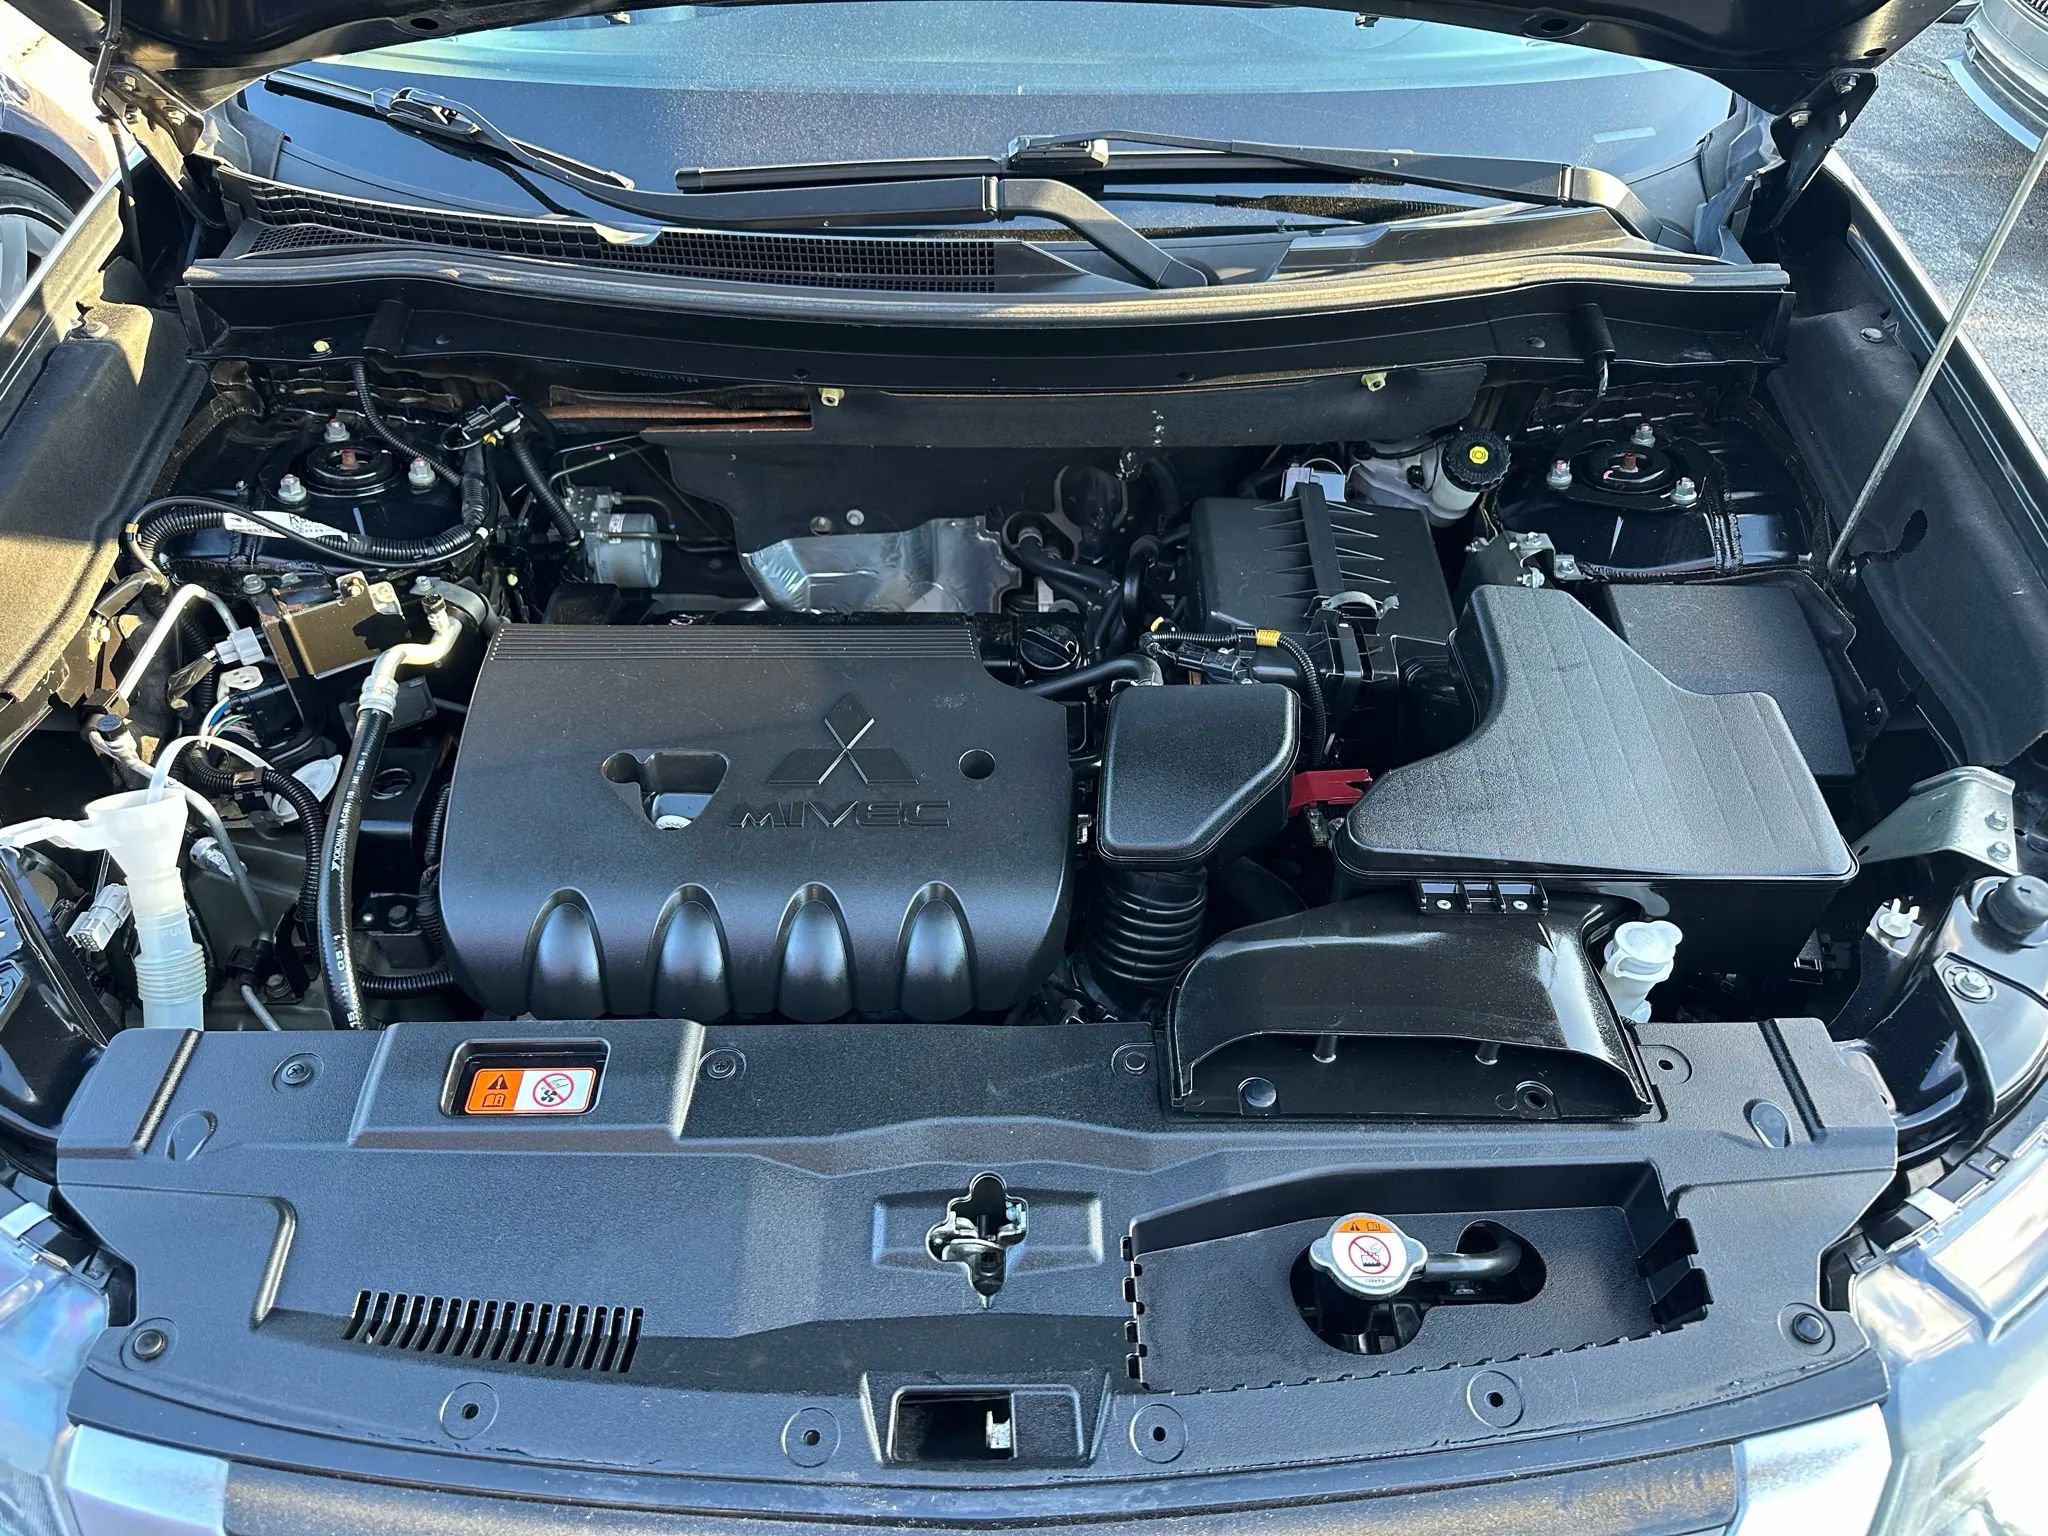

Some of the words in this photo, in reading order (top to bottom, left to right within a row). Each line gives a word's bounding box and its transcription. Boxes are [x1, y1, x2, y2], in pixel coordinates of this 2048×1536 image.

[333, 828, 346, 861] YOKOHAMA
[352, 775, 360, 785] HI
[727, 799, 951, 829] MIVEC
[335, 950, 345, 971] 05
[339, 981, 349, 997] HI
[346, 1011, 357, 1029] 15
